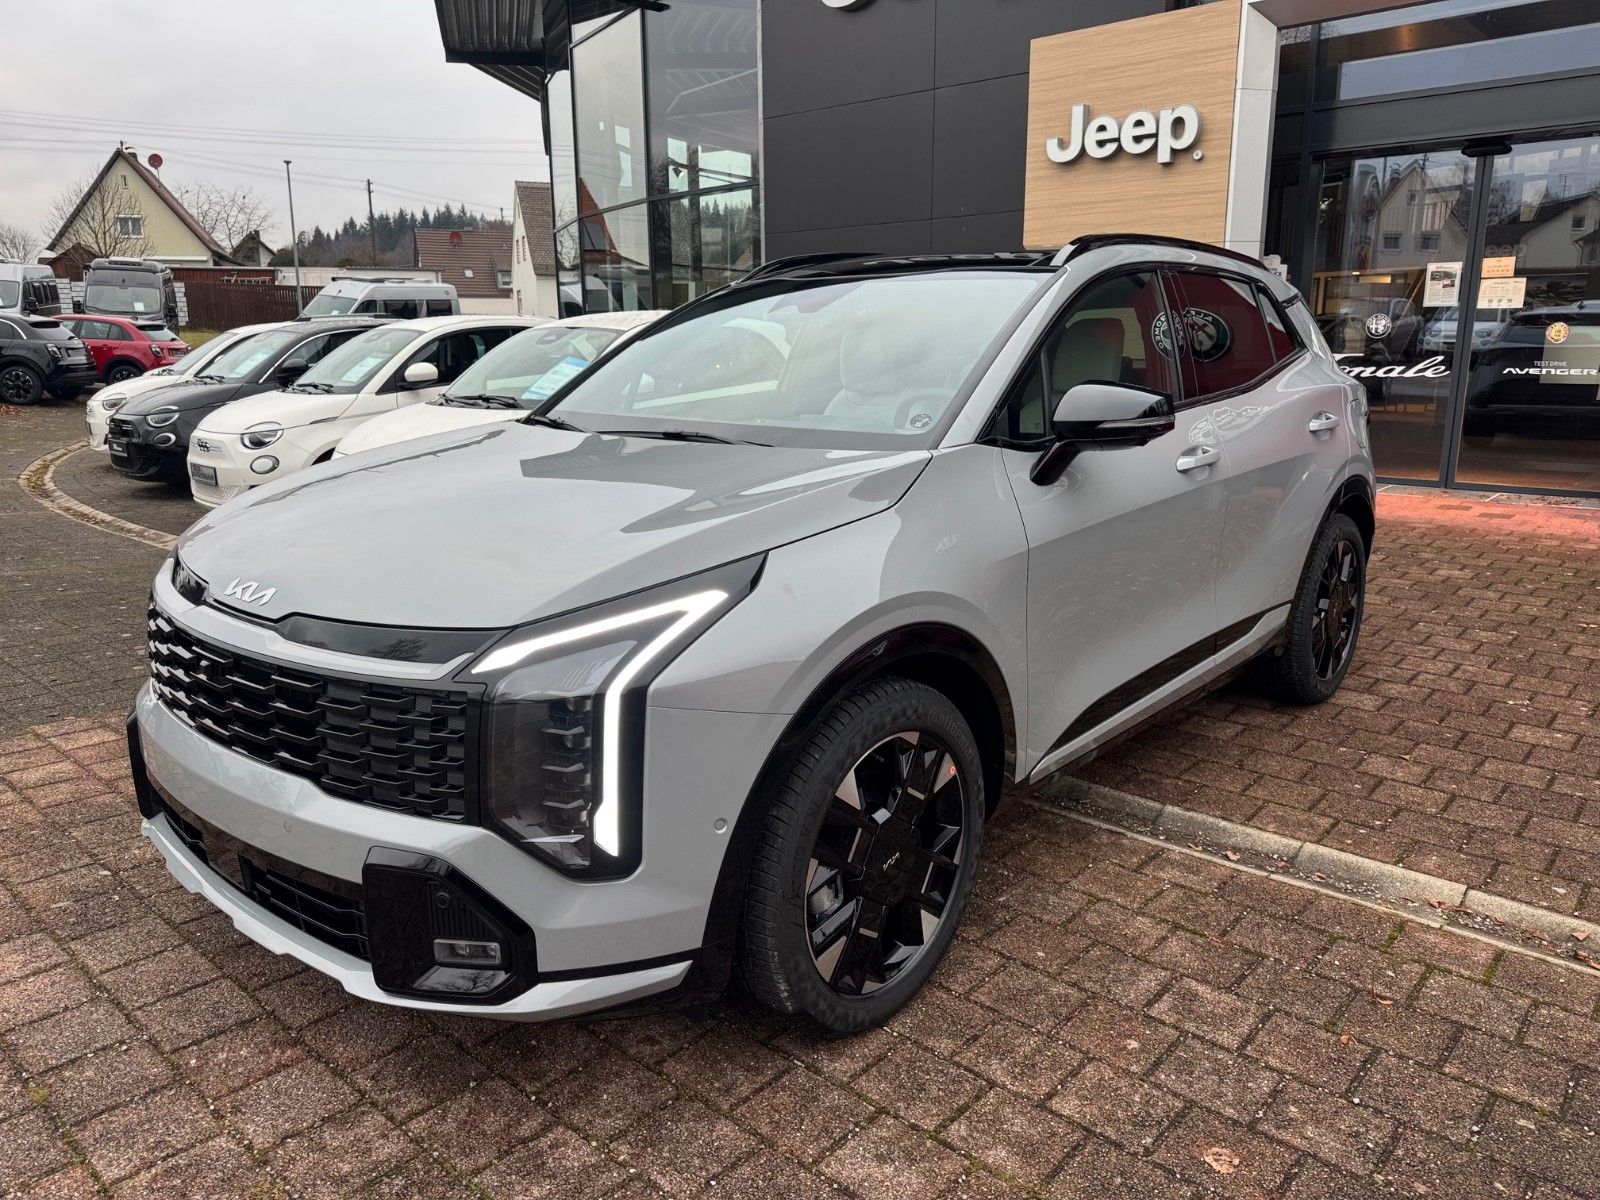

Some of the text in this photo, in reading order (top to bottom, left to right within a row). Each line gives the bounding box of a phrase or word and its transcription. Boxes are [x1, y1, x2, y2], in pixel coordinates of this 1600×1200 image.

[1046, 104, 1200, 164] Jeep
[1502, 367, 1598, 376] AVENGER
[223, 577, 278, 606] KIA
